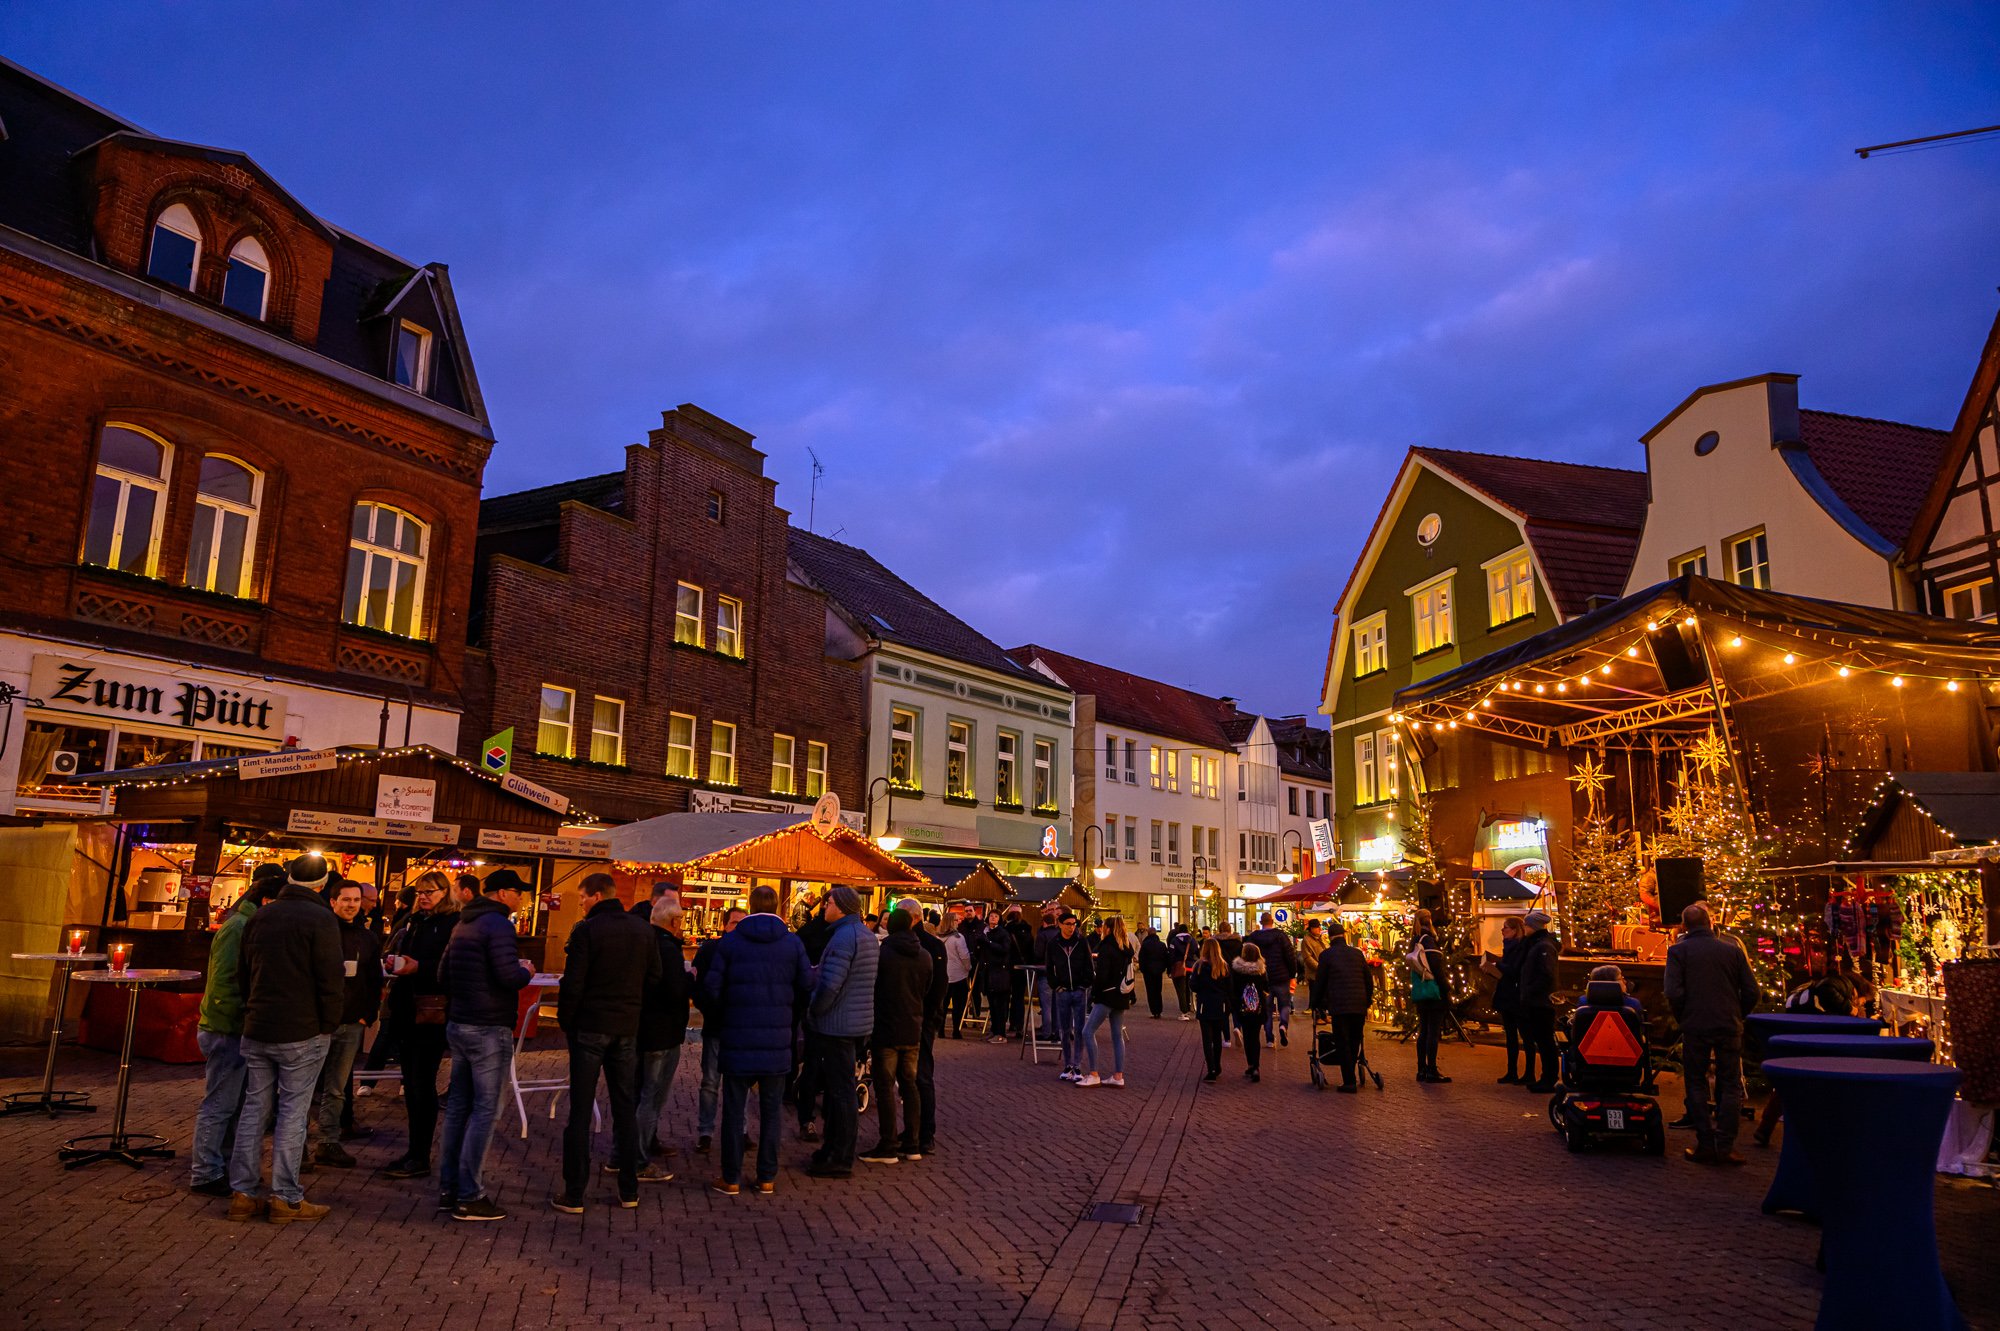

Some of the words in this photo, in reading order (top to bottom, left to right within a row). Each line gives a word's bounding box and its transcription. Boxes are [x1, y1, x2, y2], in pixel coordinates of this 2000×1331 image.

[51, 663, 164, 716] Zum
[171, 682, 273, 731] Pütt
[296, 752, 322, 762] Punsch
[260, 763, 301, 774] Eierpunsch
[507, 778, 551, 804] Glühwein
[385, 809, 422, 817] CONFISERIE
[338, 817, 368, 826] Glühwein
[385, 829, 412, 837] Glühwein
[903, 826, 945, 840] stephanus
